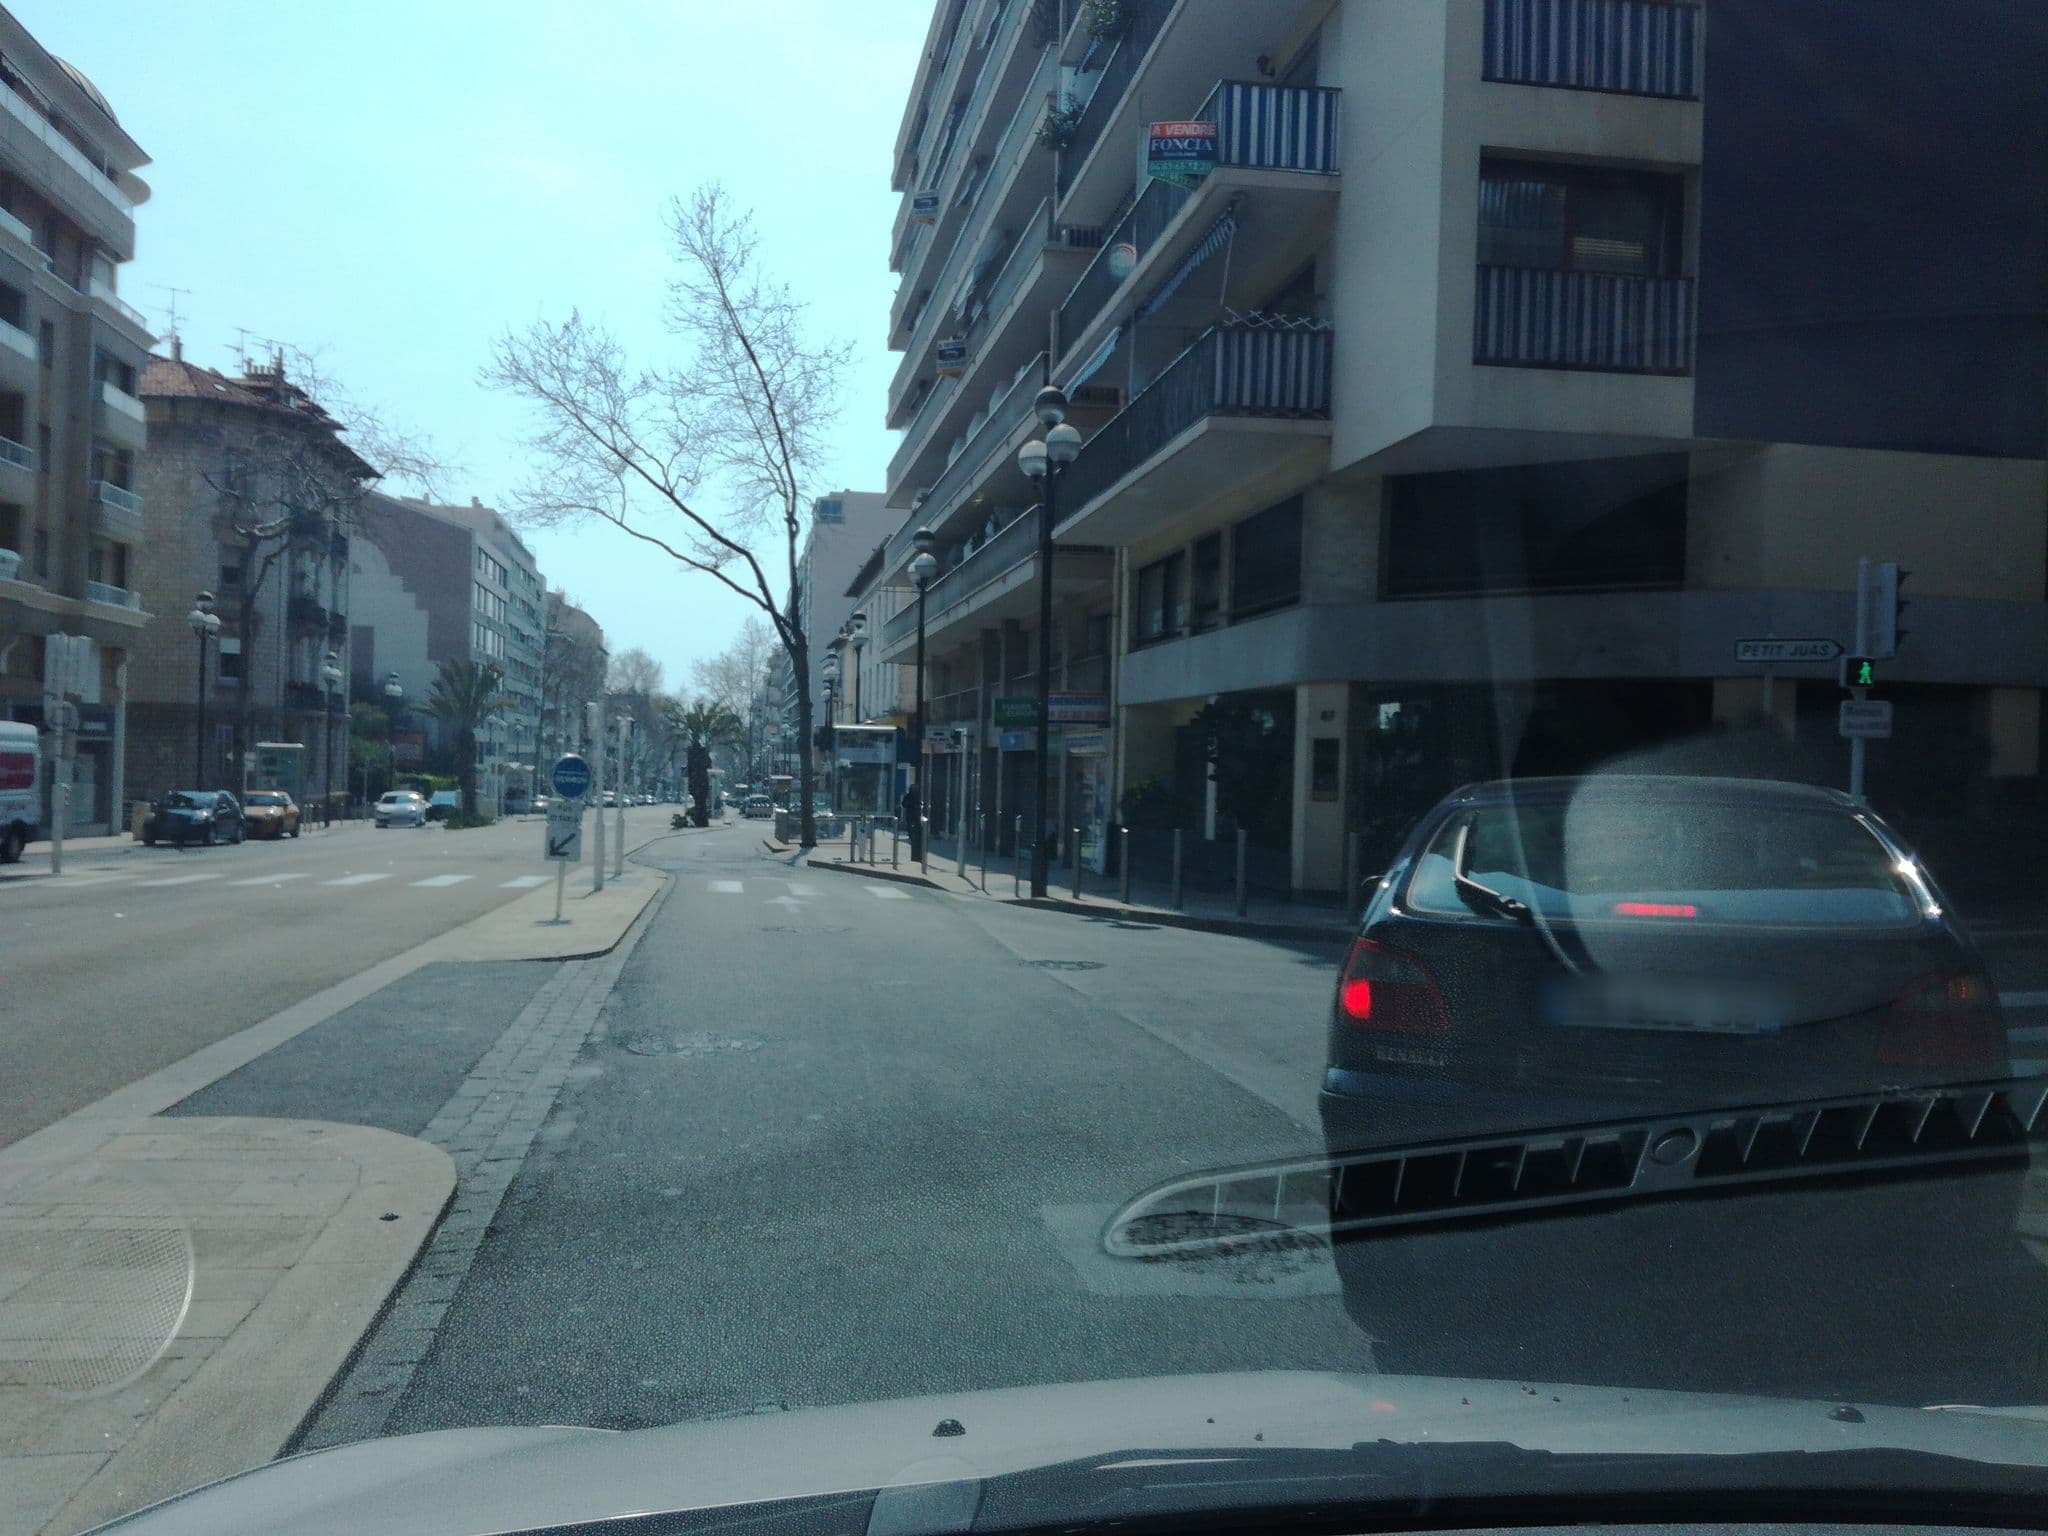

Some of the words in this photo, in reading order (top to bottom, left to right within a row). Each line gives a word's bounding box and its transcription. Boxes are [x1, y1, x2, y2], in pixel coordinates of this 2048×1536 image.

[1165, 124, 1216, 136] VENDRE
[1151, 138, 1213, 151] FONCIA
[1743, 644, 1784, 656] PETIT
[1789, 644, 1831, 656] JUAS
